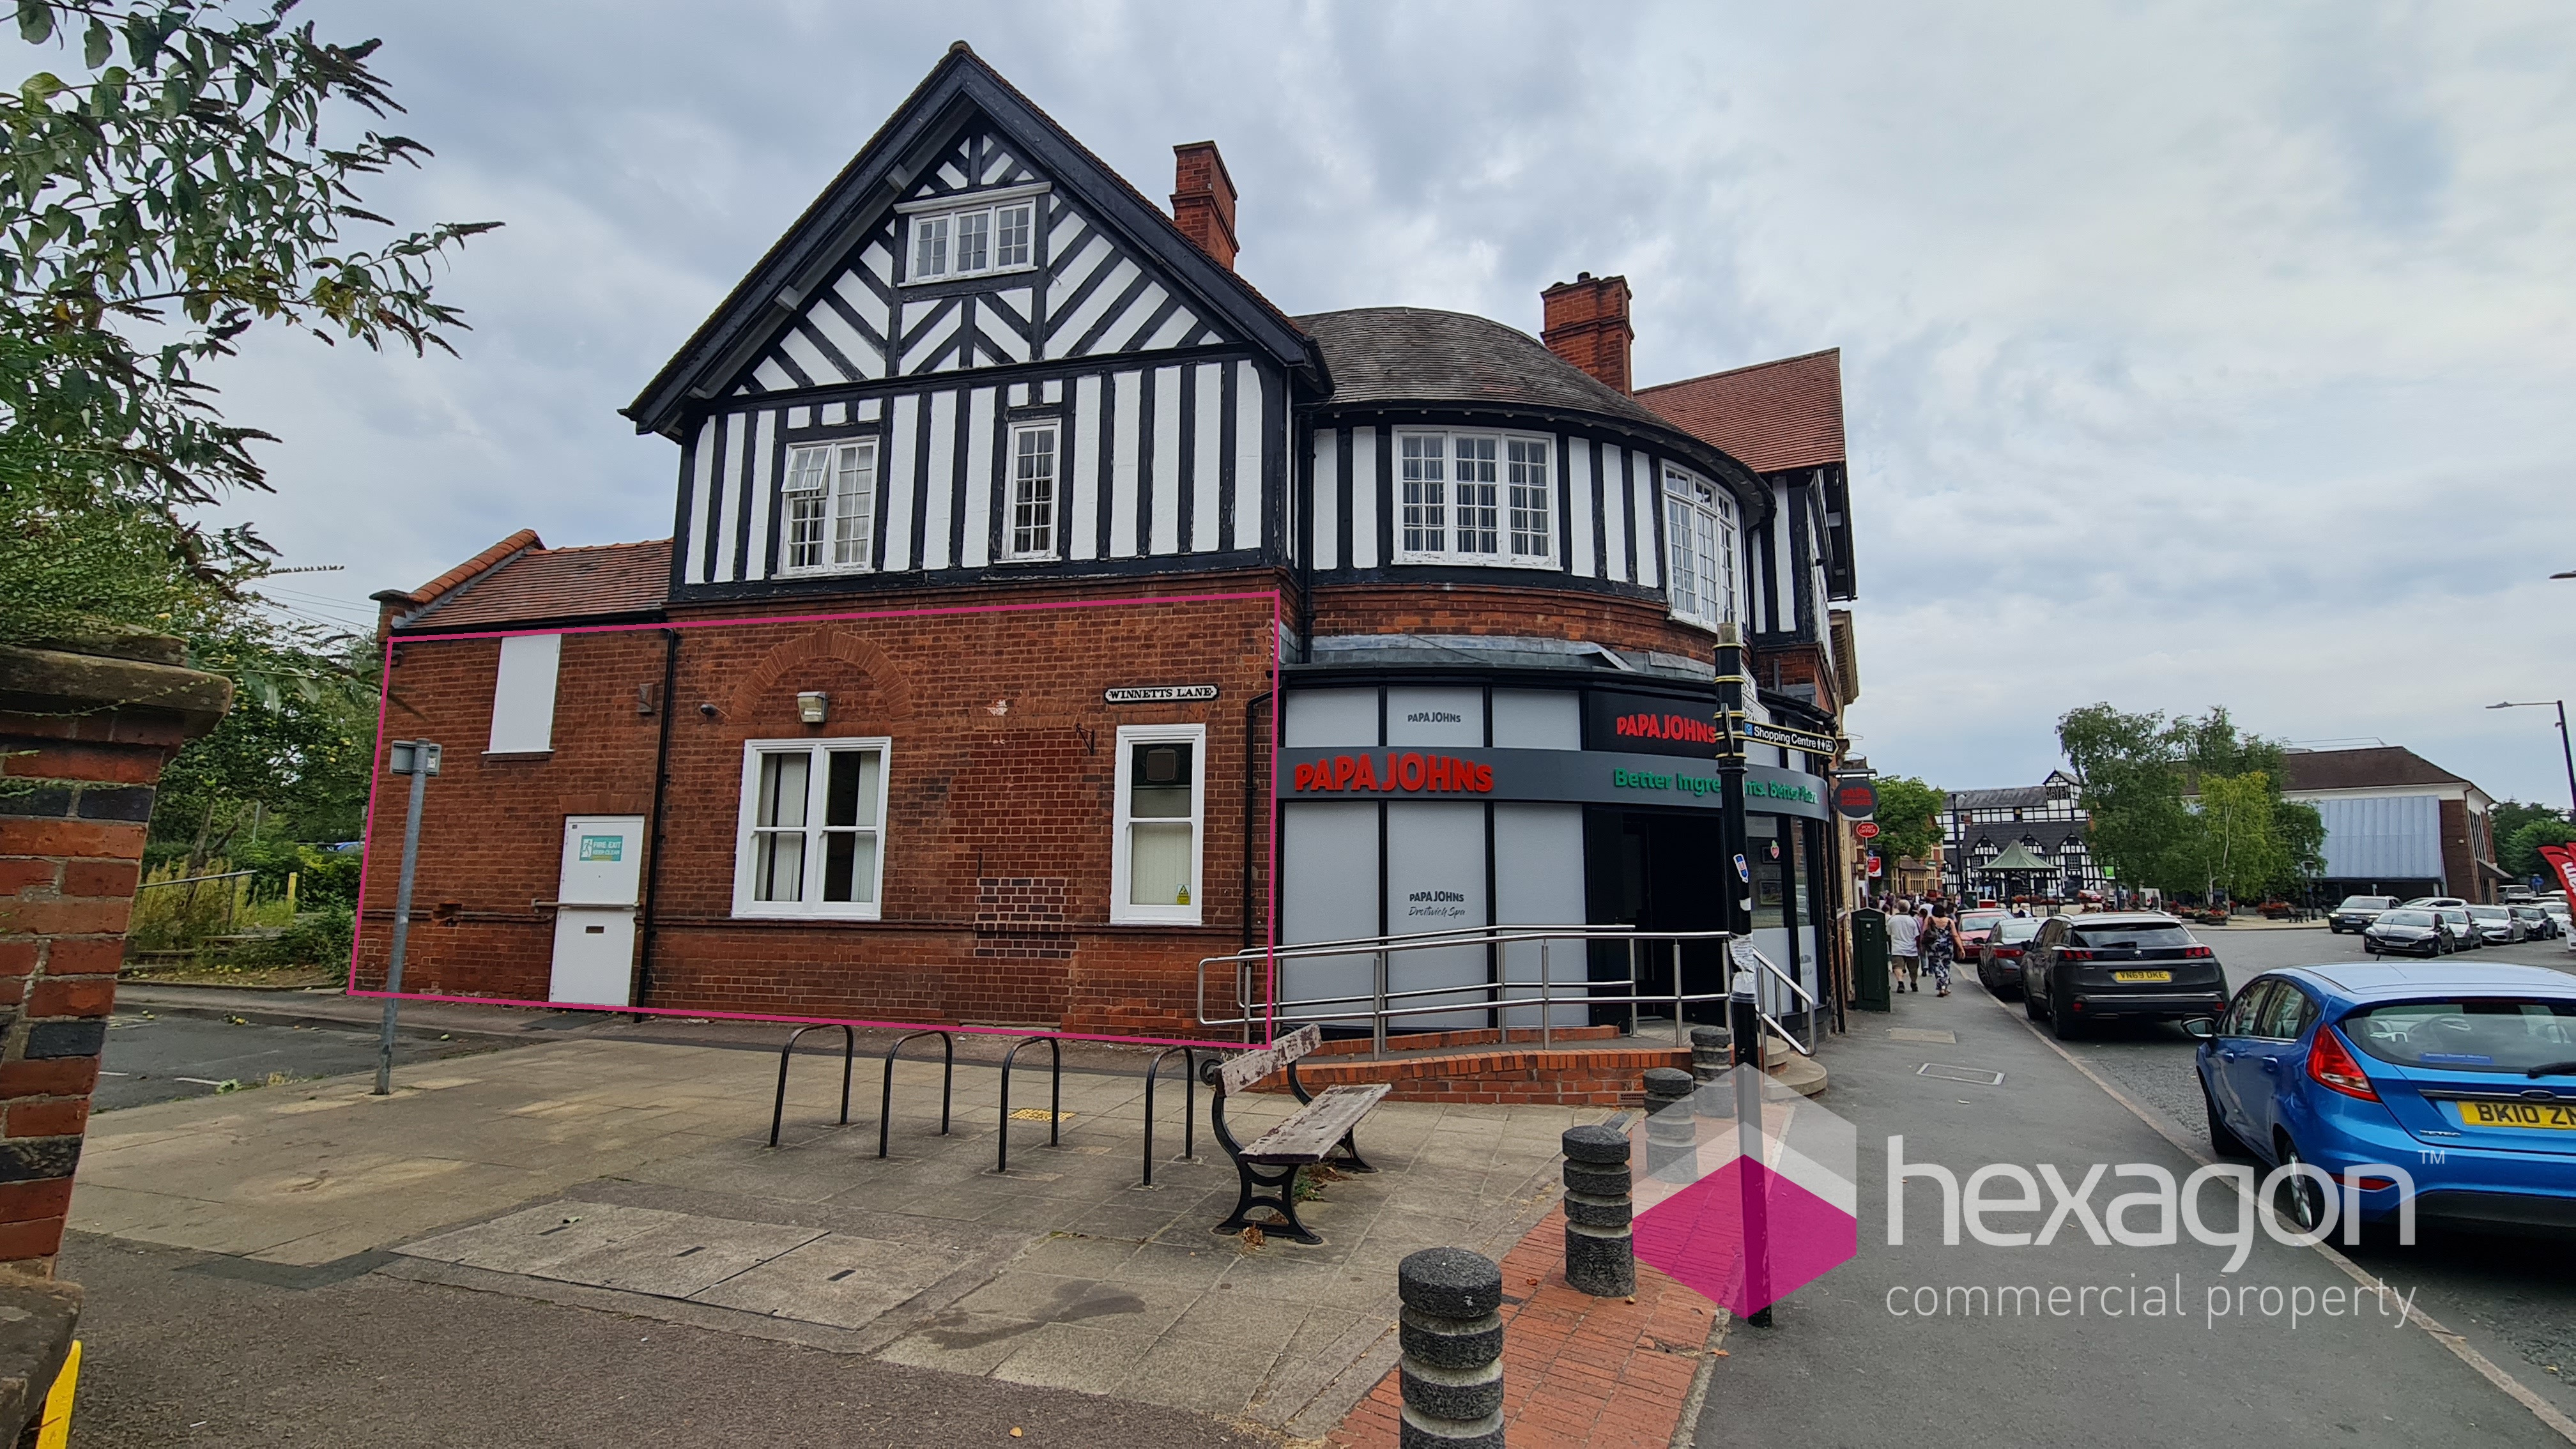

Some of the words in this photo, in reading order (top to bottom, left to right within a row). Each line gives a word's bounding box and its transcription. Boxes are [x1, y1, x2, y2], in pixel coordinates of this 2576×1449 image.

[1110, 689, 1173, 699] WINNETTS
[1177, 687, 1212, 697] LANE
[1407, 712, 1430, 723] PAPA
[1431, 712, 1461, 723] JOHNS
[1616, 713, 1661, 738] PAPA
[1662, 714, 1717, 744] JOHNS
[1754, 726, 1790, 744] Shopping
[1791, 734, 1816, 747] Centre
[1294, 753, 1379, 792] PAPA
[1381, 752, 1494, 793] JOHNS
[1614, 768, 1672, 789] Better
[1677, 771, 1767, 797] Ingrents.
[1409, 891, 1433, 902] PAPA
[1433, 891, 1464, 902] JOHNS
[1448, 907, 1466, 919] Spa
[2474, 1103, 2540, 1124] BK10
